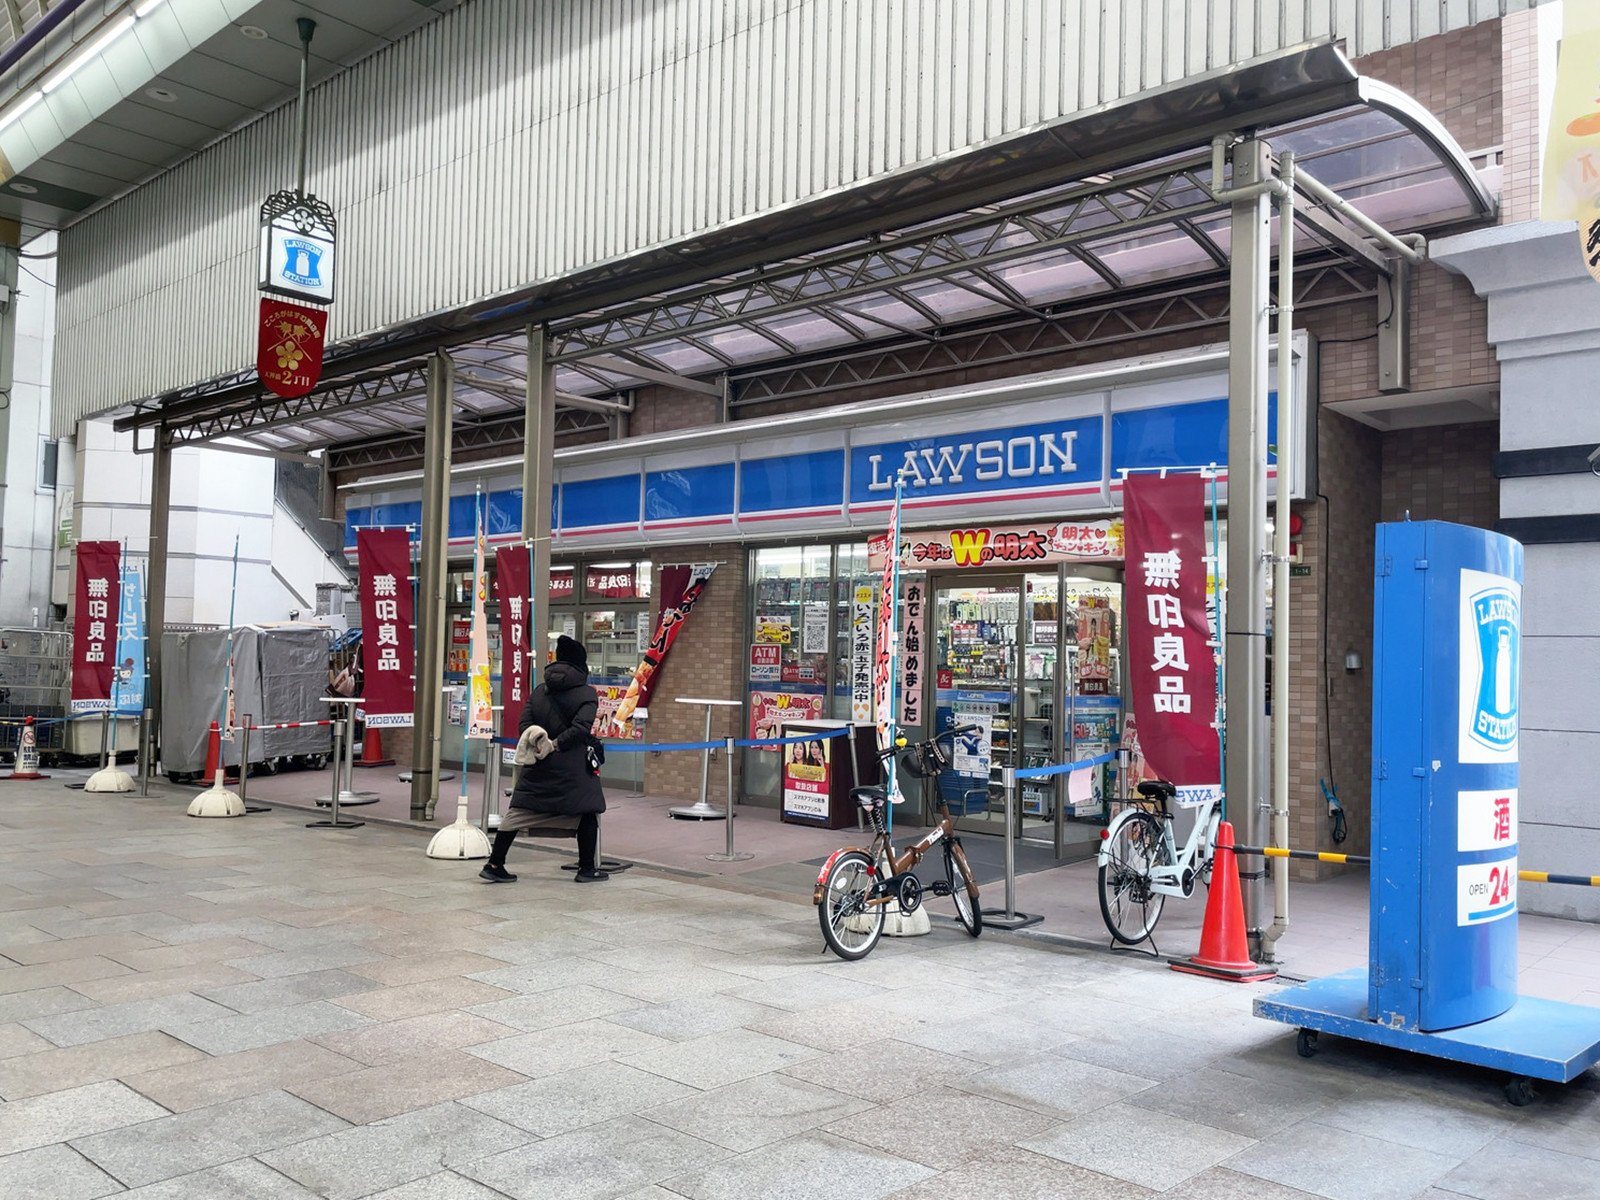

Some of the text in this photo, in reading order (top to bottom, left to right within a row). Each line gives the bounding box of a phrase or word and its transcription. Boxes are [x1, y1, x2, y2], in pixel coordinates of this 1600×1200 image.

[285, 240, 323, 256] LAWSON
[284, 271, 320, 285] STATION
[868, 430, 1078, 491] LAWSON
[913, 529, 1048, 567] 今年はWの明太
[1062, 526, 1094, 541] 明太
[751, 666, 779, 674] ローソン銀行
[754, 646, 777, 658] ATM
[855, 603, 871, 702] いろいろ赤玉子発売中
[905, 586, 923, 724] おでん始めました
[1493, 798, 1511, 841] 酒
[1469, 883, 1489, 896] OPEN
[1488, 865, 1510, 906] 24
